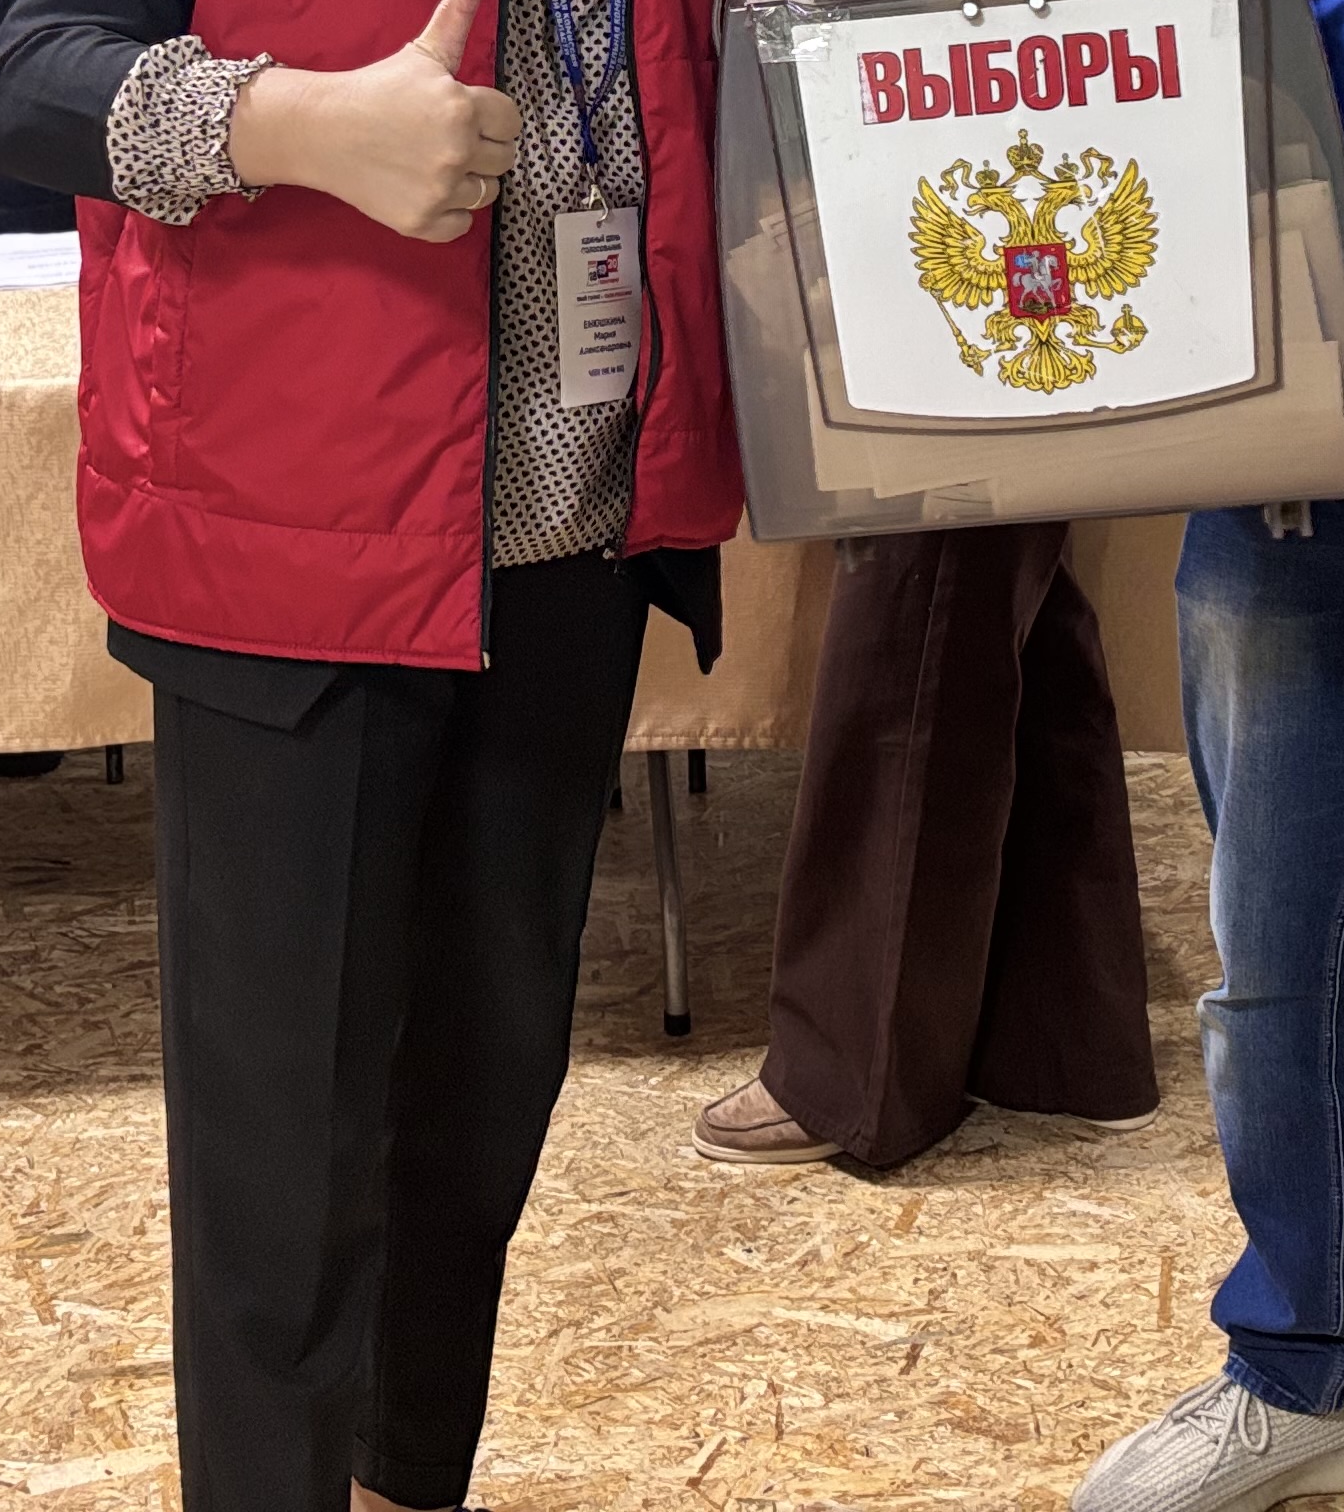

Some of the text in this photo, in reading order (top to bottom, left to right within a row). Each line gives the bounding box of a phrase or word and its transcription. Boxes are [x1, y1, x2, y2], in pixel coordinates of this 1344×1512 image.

[554, 11, 570, 56] ОБЛАСТИ
[561, 11, 578, 68] КОМИССИЯ
[859, 24, 1183, 126] ВЫБОРЫ
